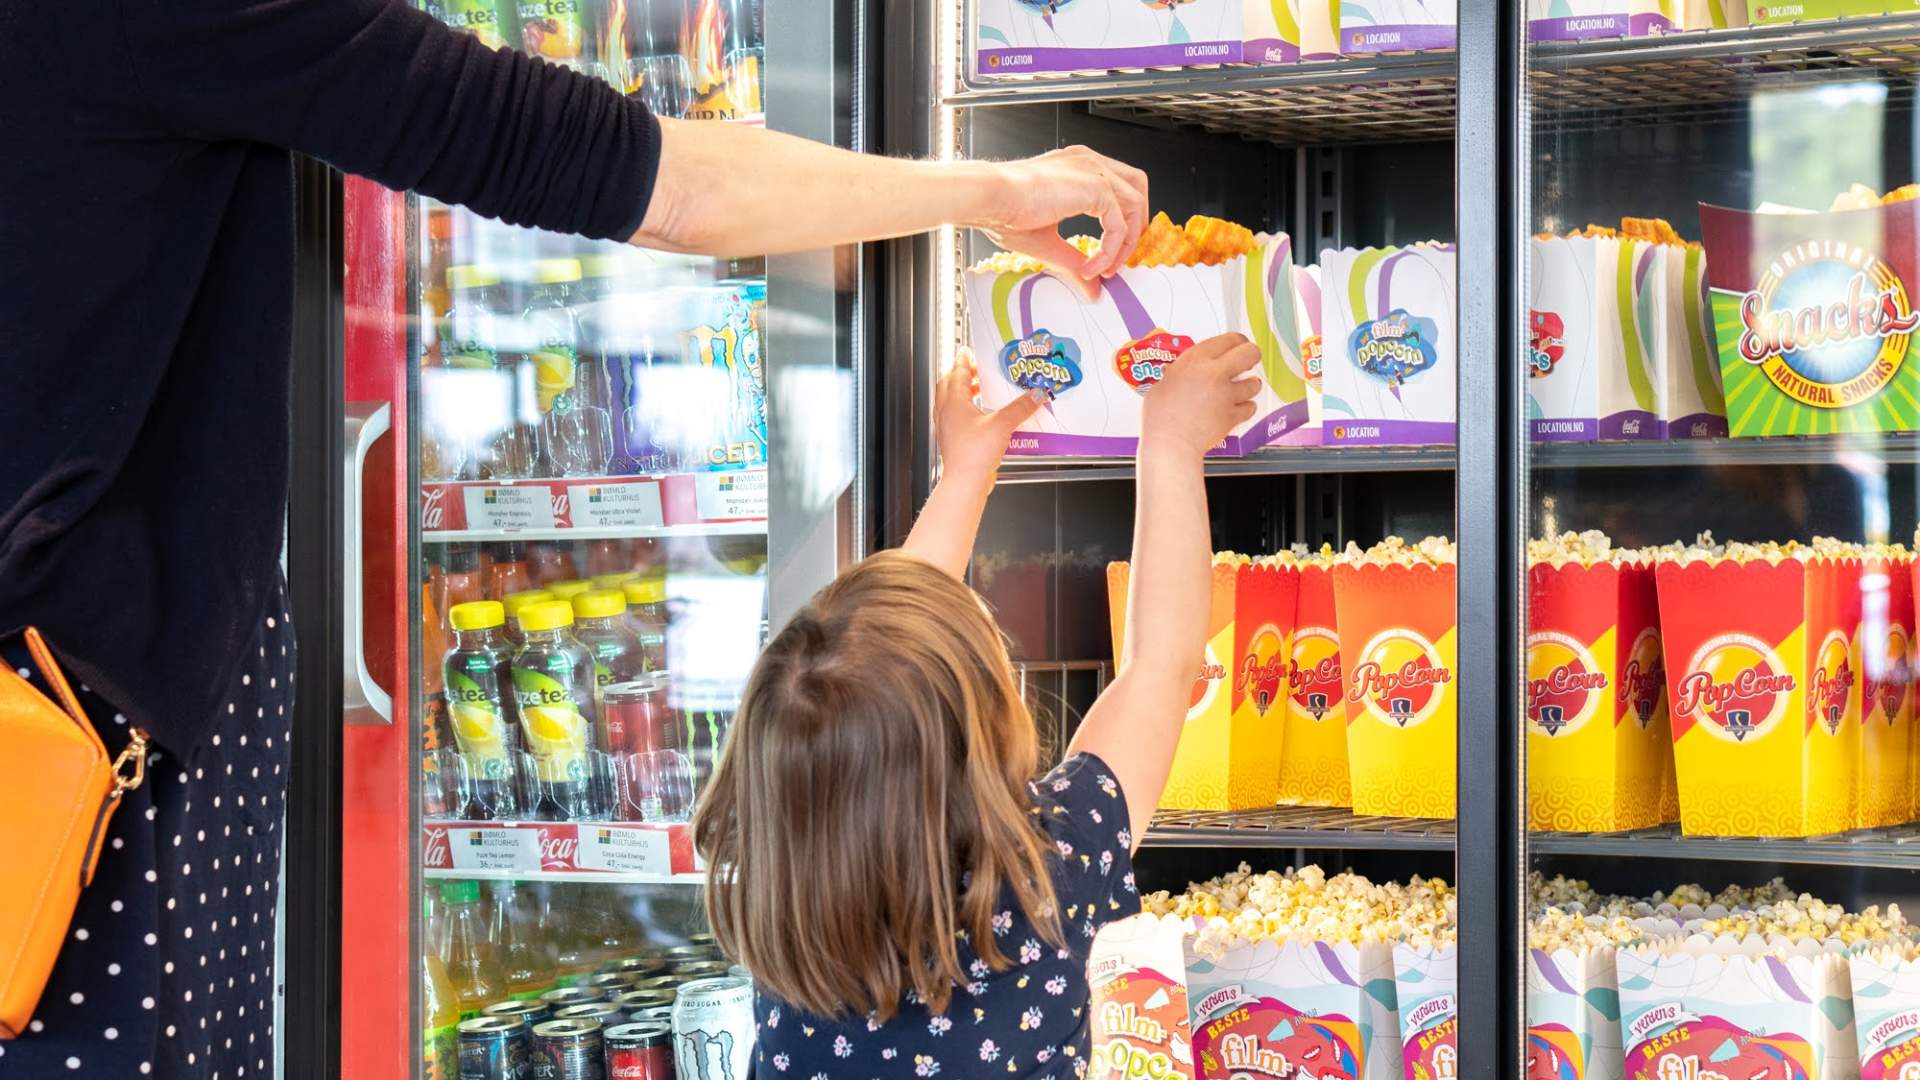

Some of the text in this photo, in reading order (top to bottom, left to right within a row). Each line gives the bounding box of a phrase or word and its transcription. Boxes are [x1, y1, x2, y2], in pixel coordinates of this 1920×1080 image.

[519, 0, 577, 17] uzetea
[1184, 44, 1229, 57] LOCATION.NO
[1366, 32, 1400, 45] LOCATION
[1001, 54, 1033, 66] LOCATION
[1770, 238, 1875, 279] ORIGINAL
[1371, 320, 1404, 338] film
[1740, 272, 1919, 363] Snacks
[1019, 339, 1050, 357] film
[1357, 339, 1424, 366] popcorn
[1009, 357, 1071, 384] popcorn
[1131, 361, 1168, 381] sna
[1772, 357, 1895, 405] NATURAL SNACKS
[1346, 425, 1381, 439] LOCATION
[1537, 421, 1585, 434] LOCATION.NO
[1008, 437, 1040, 449] LOCATION
[515, 687, 569, 704] uzetea
[1349, 660, 1452, 704] PopCorn
[1676, 667, 1797, 717] PopCorn
[1207, 1007, 1251, 1041] BESTE
[1410, 998, 1449, 1027] verdens
[1633, 1006, 1676, 1036] verdens
[1872, 1012, 1918, 1044] verdens
[1642, 1026, 1691, 1061] BESTE
